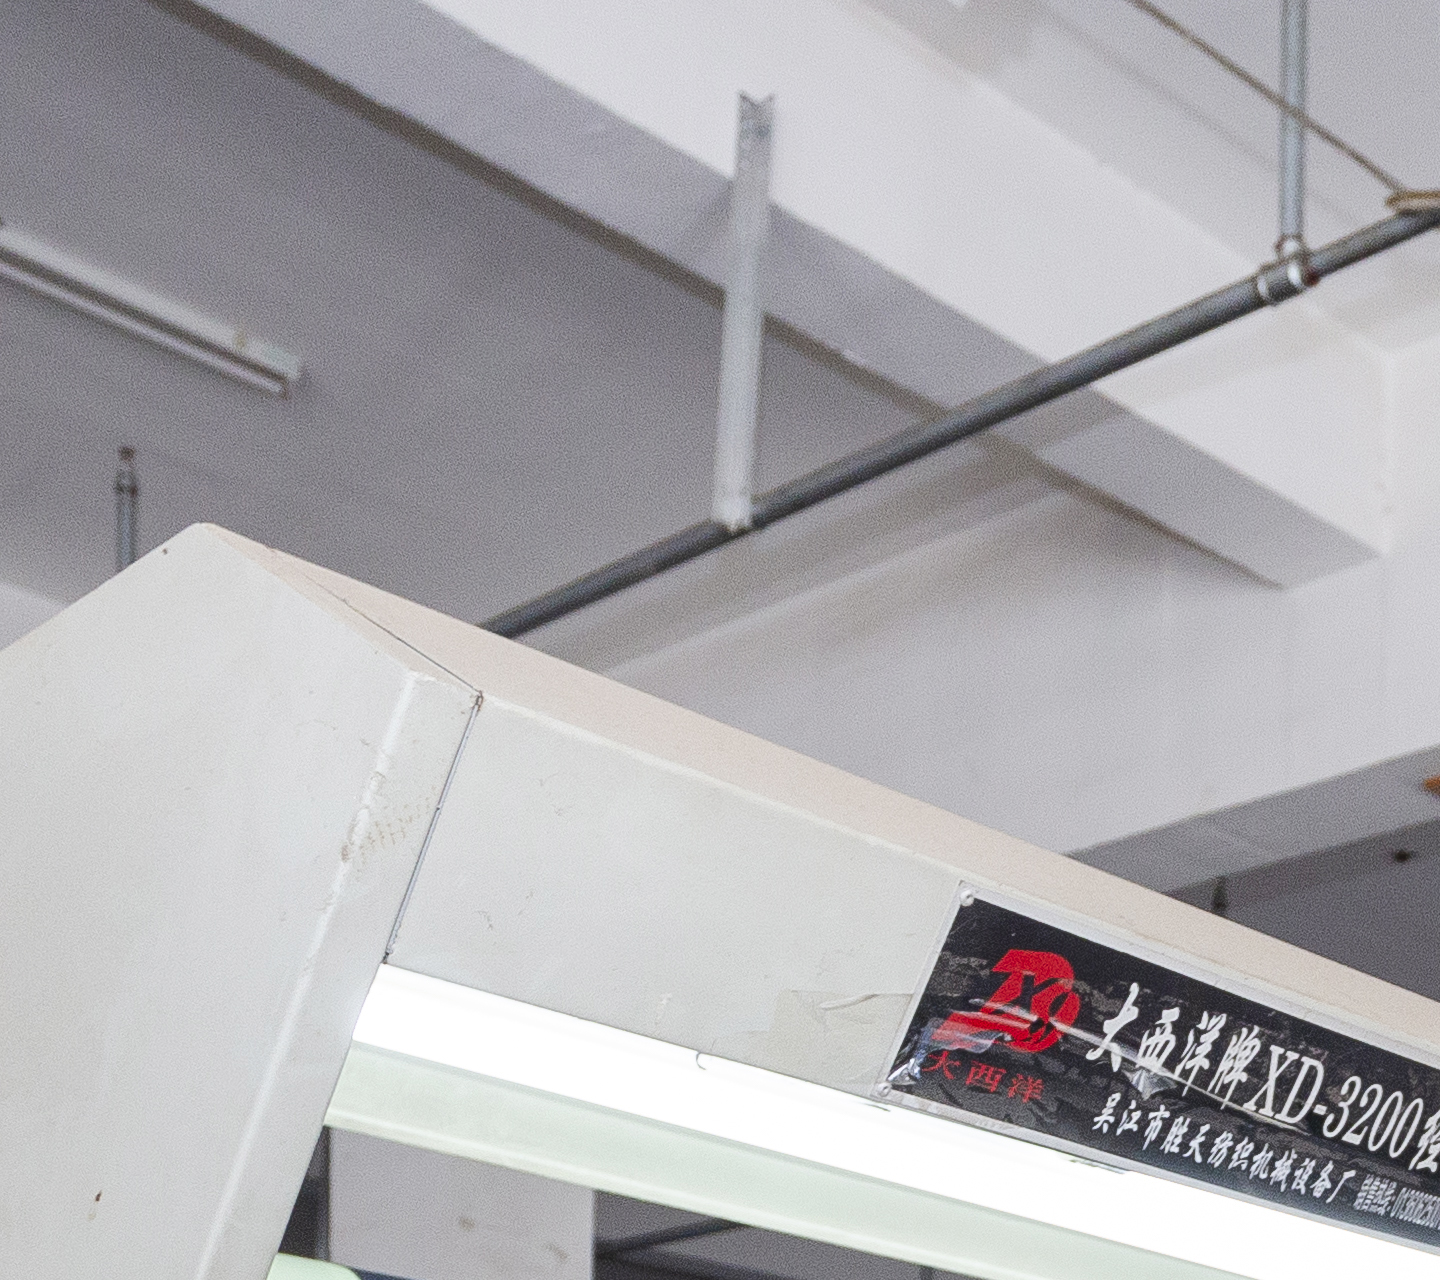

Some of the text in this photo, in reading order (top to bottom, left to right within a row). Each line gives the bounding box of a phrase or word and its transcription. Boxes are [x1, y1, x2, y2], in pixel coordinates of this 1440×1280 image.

[922, 1051, 1045, 1104] 大西洋
[1091, 1092, 1356, 1204] 吴江市胜天纺织机械设备厂
